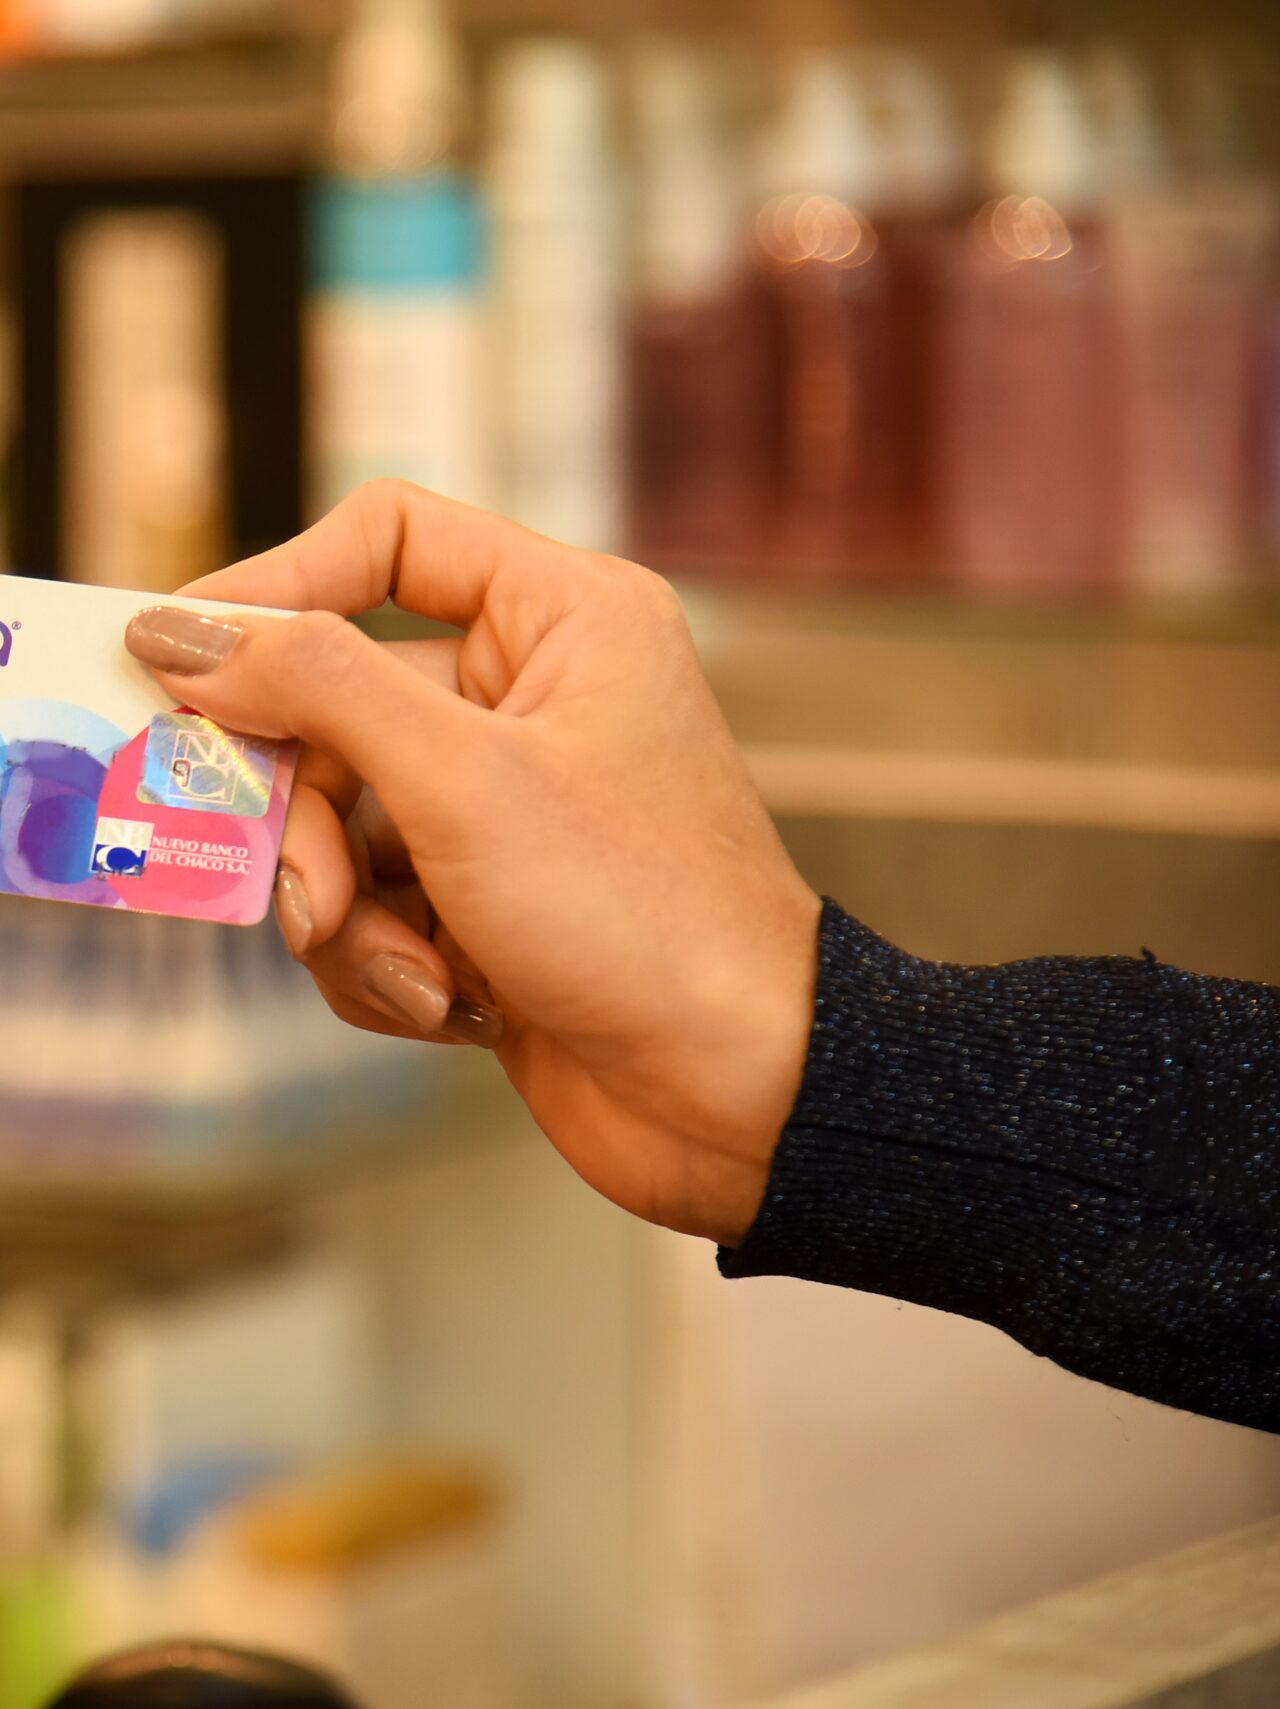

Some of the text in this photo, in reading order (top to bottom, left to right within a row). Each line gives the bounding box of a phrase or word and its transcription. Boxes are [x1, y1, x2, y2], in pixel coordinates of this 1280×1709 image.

[150, 835, 249, 860] NUEVO BANCO
[149, 851, 250, 875] DEL CHACO S.A.
